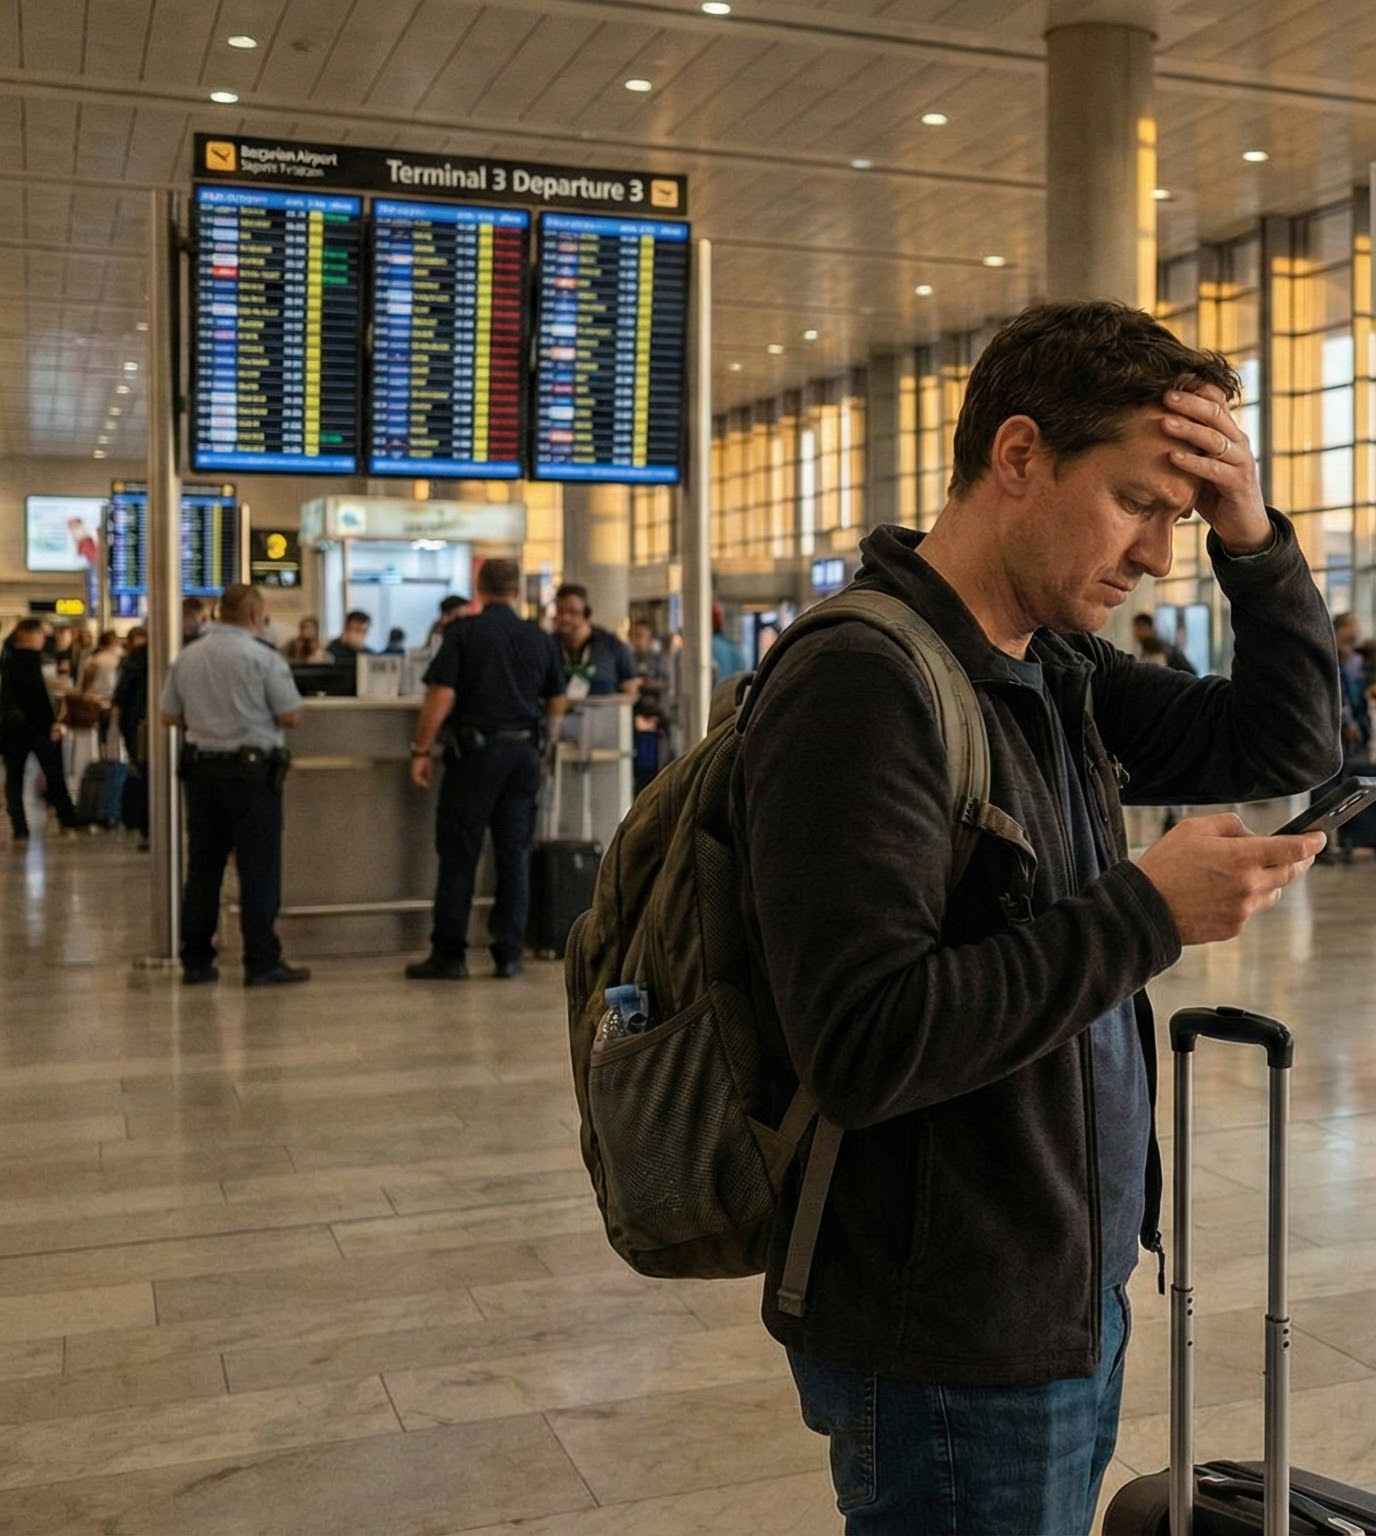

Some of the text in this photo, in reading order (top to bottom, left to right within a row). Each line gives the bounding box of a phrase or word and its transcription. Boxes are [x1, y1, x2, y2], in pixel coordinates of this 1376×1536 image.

[386, 158, 643, 202] Terminal 3 Departure 3
